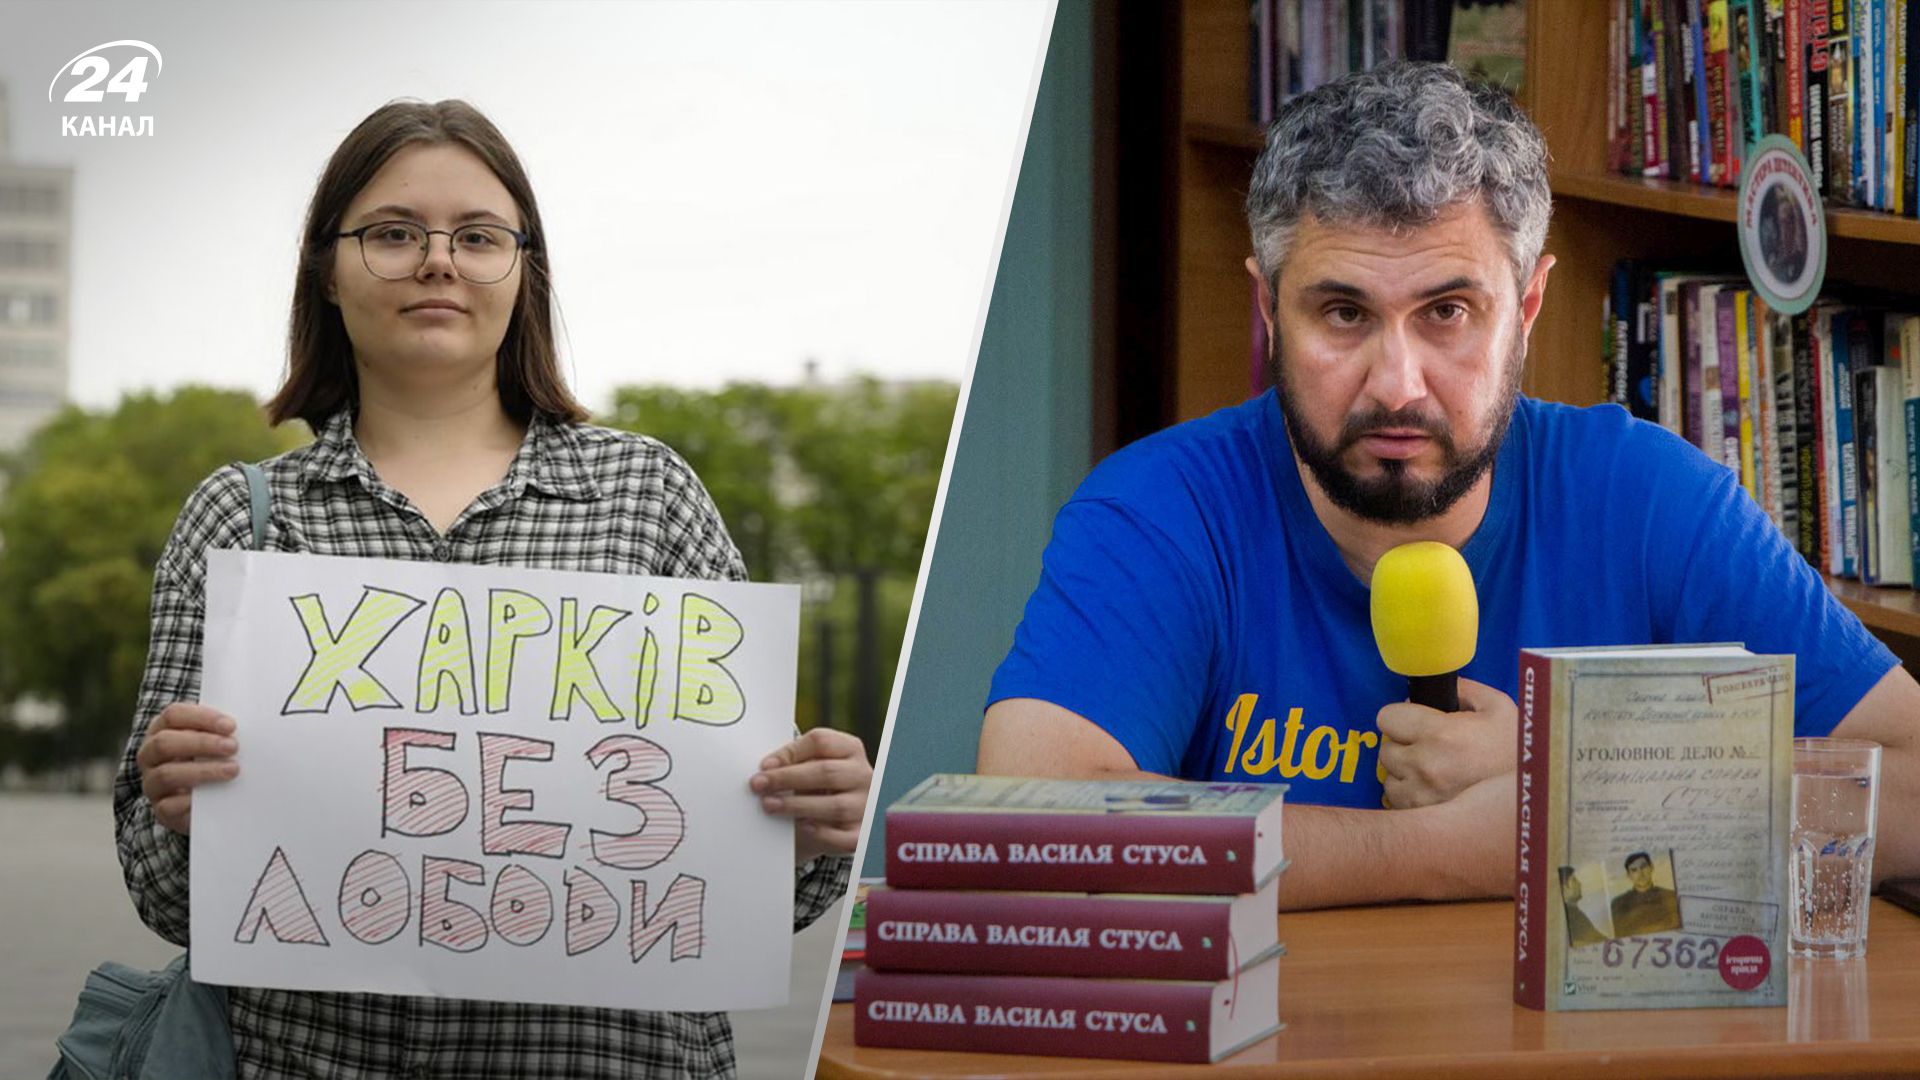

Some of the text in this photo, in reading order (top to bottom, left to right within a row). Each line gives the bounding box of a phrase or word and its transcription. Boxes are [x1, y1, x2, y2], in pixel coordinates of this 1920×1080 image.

[1576, 747, 1675, 761] УГОЛОВНОЕ
[1680, 746, 1724, 761] ДЕЛО
[380, 727, 686, 870] БЕЗ
[1518, 666, 1535, 962] СПРАВА ВАСИЛЯ СТУСА
[898, 842, 1207, 866] СПРАВА ВАСИЛЯ СТУСА
[877, 921, 1183, 951] СПРАВА ВАСИЛЯ СТУСА
[1603, 938, 1720, 970] 67362
[868, 1001, 1168, 1034] СПРАВА ВАСИЛЯ СТУСА
